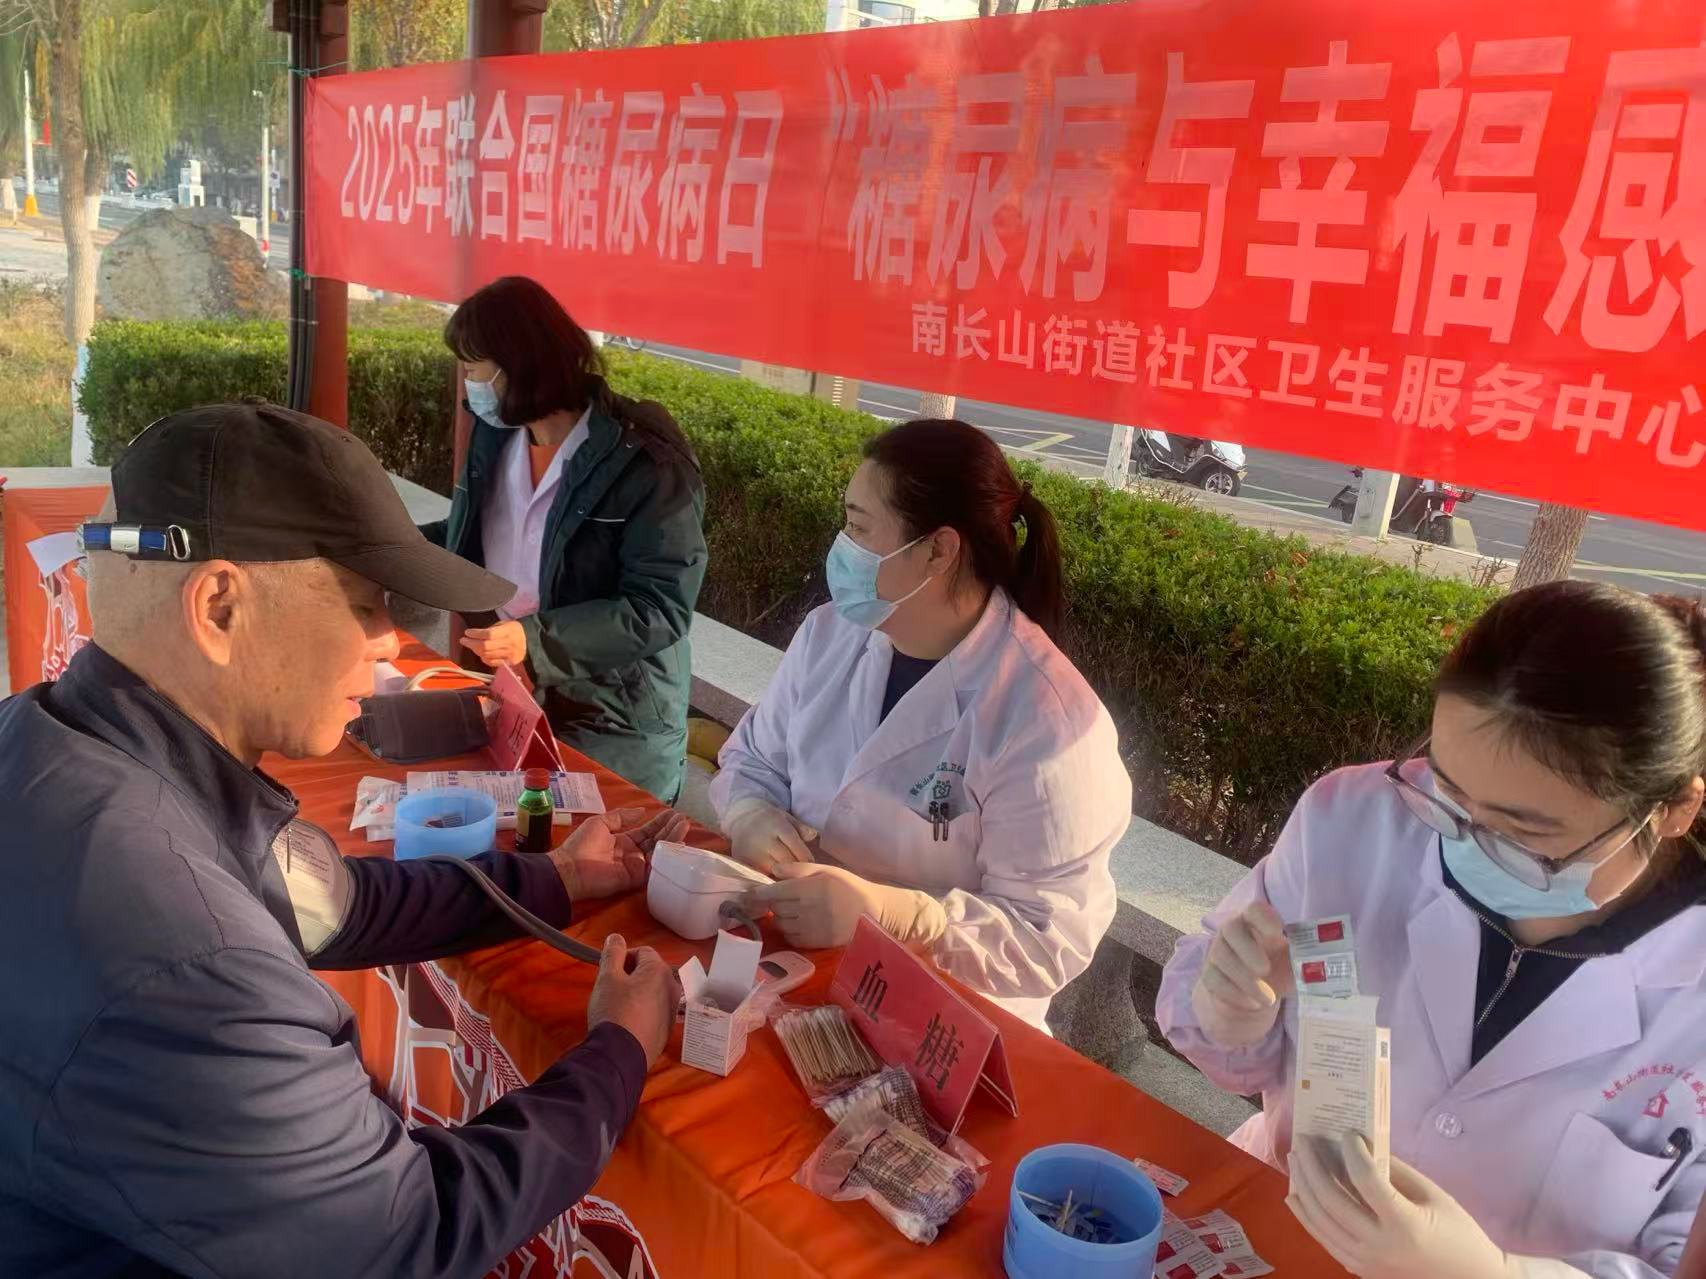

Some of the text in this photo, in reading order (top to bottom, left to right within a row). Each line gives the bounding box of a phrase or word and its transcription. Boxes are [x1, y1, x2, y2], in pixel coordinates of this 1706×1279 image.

[341, 83, 783, 267] 2025年联合国糖尿病日
[911, 302, 1706, 468] 南长山街道社区卫生服务中心
